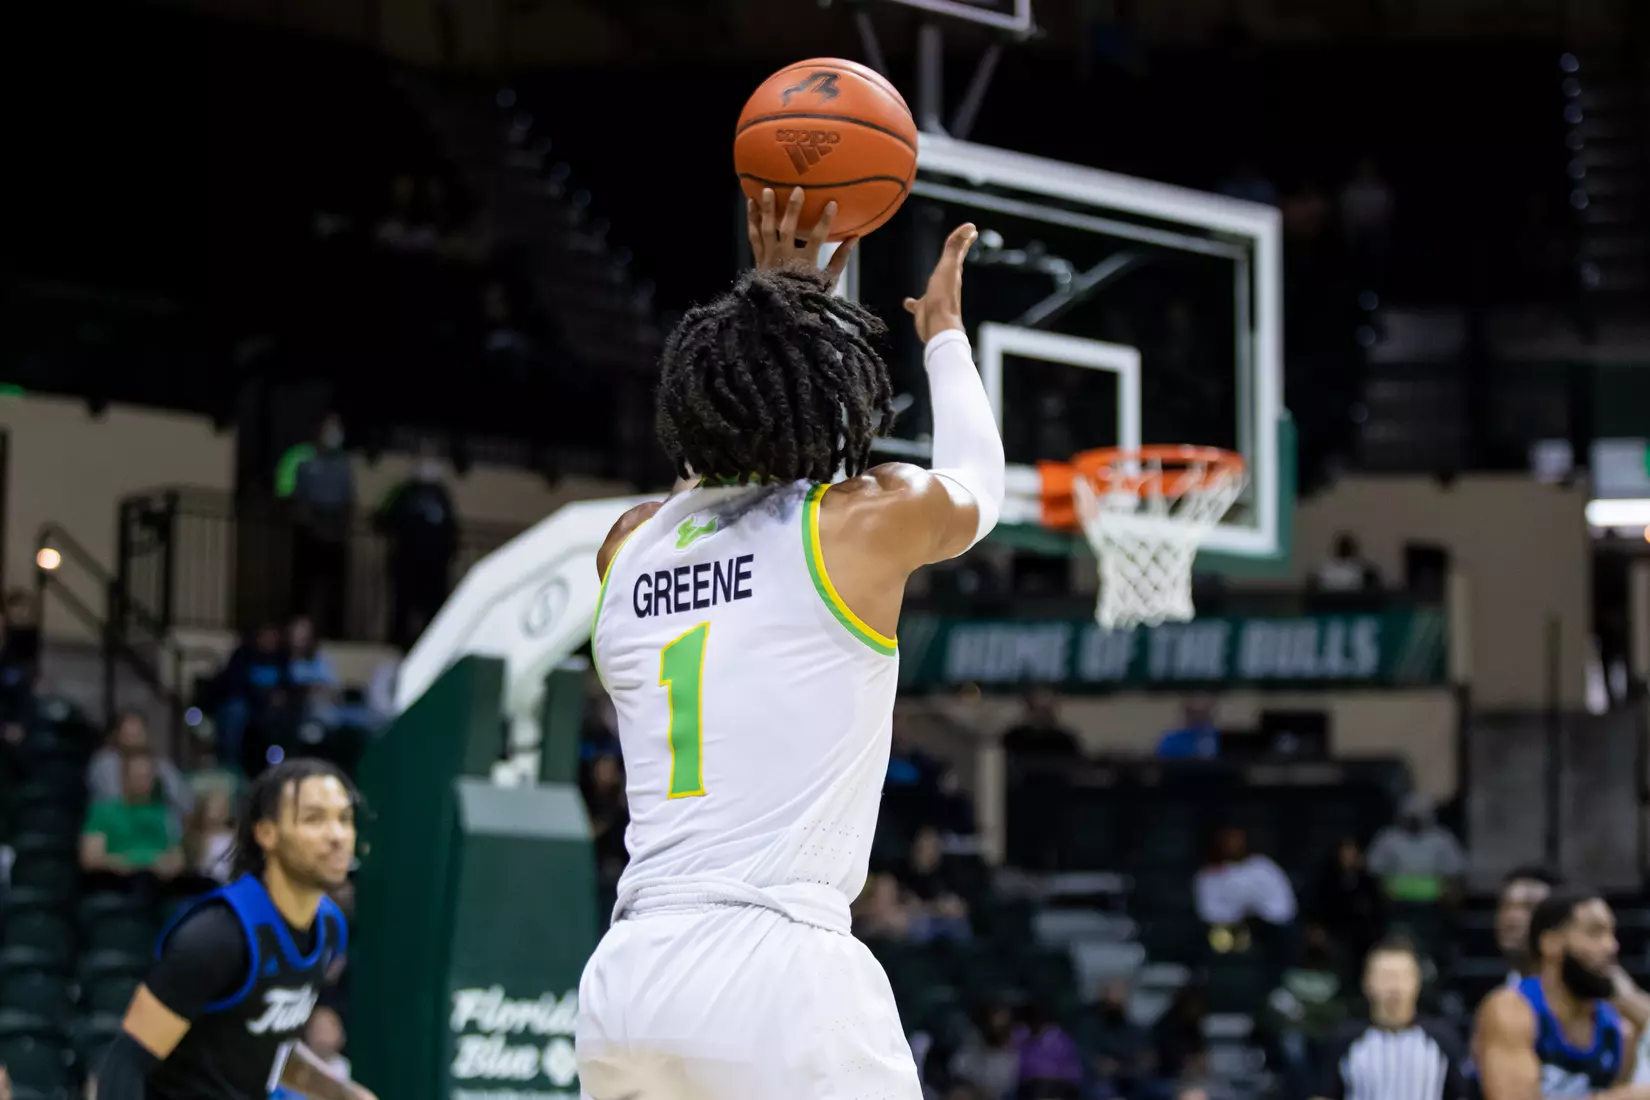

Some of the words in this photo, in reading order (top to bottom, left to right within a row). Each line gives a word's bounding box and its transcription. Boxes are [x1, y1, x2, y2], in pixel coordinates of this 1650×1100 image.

[775, 129, 841, 145] adidas
[633, 554, 754, 618] GREENE
[945, 621, 1071, 682] HOME
[1079, 621, 1139, 682] OF
[1147, 618, 1229, 680] THE
[1237, 616, 1381, 678] BULLS
[659, 622, 711, 799] 1
[450, 984, 578, 1034] Florid
[451, 1029, 539, 1080] Blue
